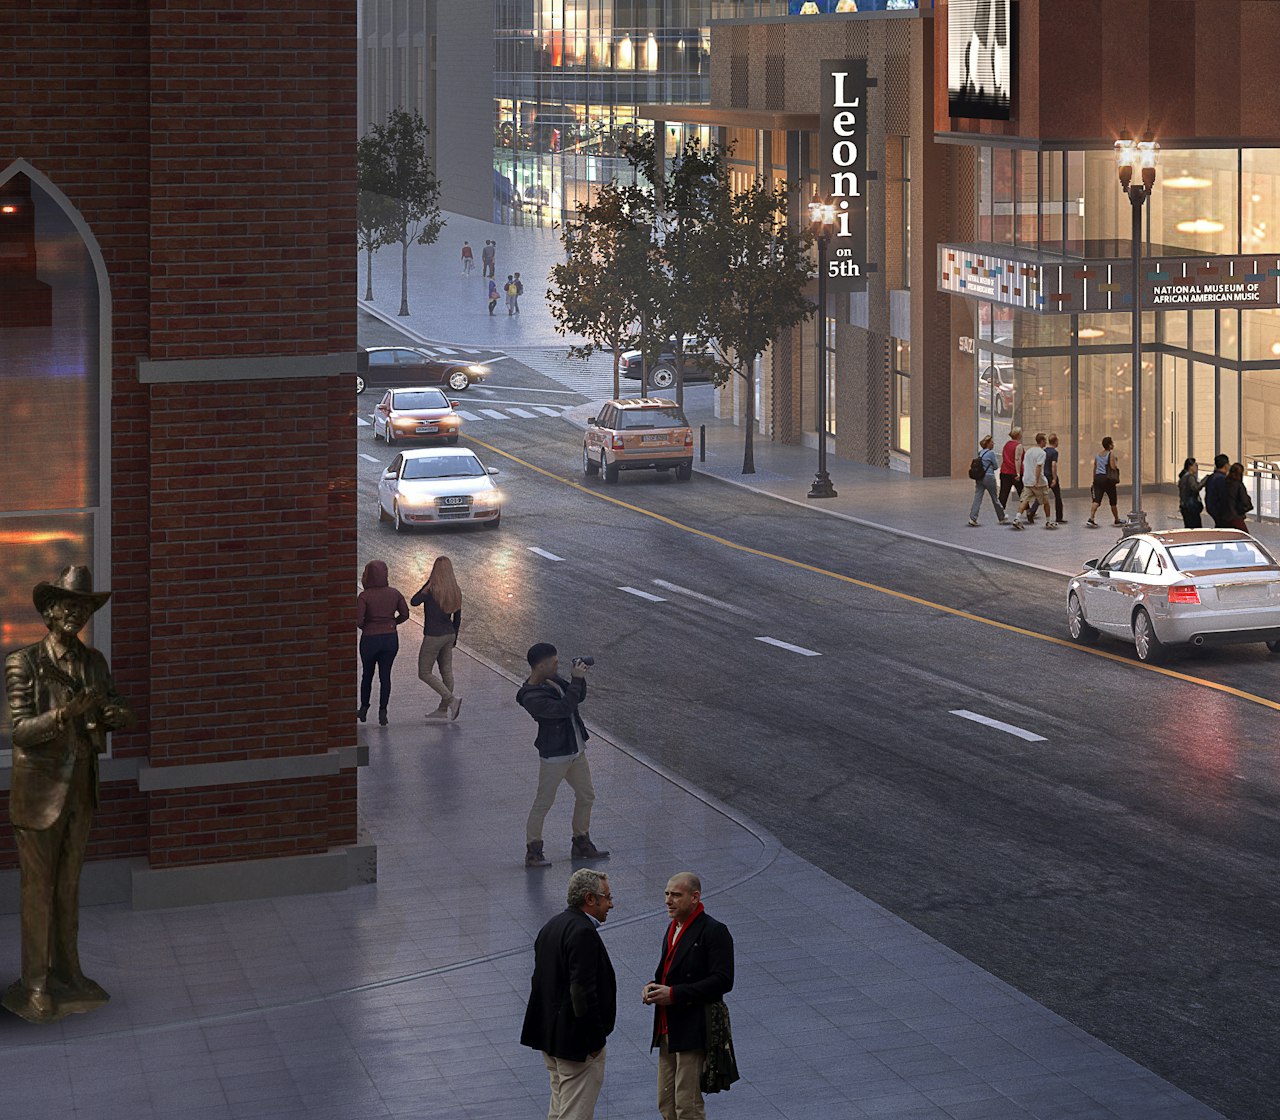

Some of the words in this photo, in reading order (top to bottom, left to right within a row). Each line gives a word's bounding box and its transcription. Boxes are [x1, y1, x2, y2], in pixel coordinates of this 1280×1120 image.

[830, 72, 861, 237] Leoni
[836, 247, 852, 257] on
[828, 259, 860, 278] 5th
[1153, 285, 1202, 295] NATIONAL
[1203, 283, 1244, 293] MUSEUM
[1247, 283, 1259, 292] OF
[1153, 295, 1190, 304] AFRICAN
[1190, 293, 1233, 303] AMERICAN
[1233, 292, 1260, 301] MUSIC
